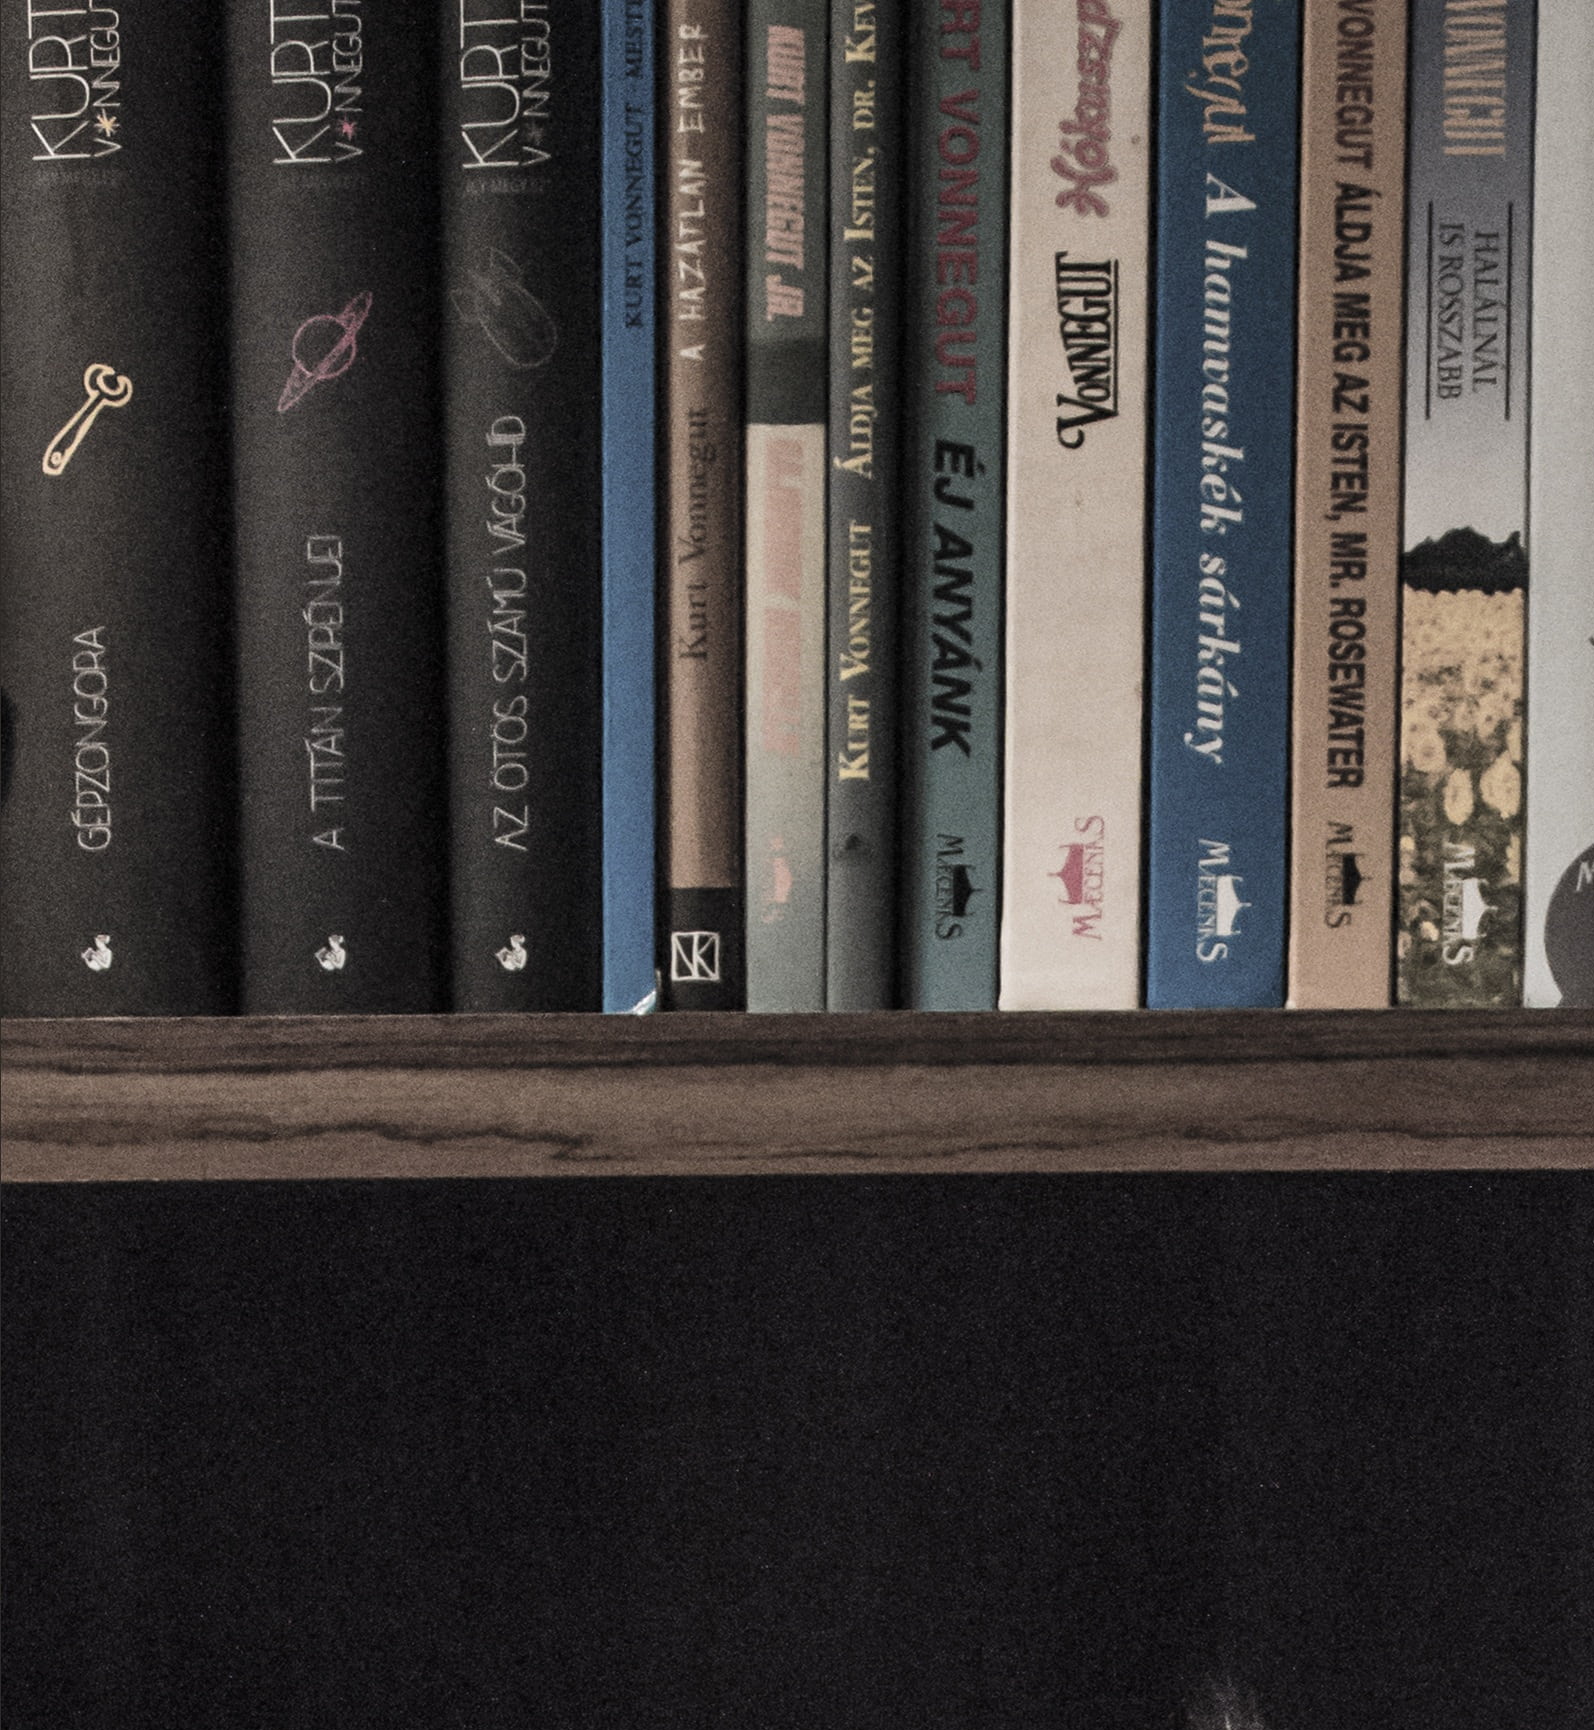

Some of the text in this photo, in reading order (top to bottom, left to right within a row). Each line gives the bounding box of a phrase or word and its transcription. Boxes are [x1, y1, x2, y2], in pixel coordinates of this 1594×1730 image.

[28, 0, 90, 161] KURT
[271, 0, 333, 163] KURT
[460, 0, 521, 168] KURT
[677, 23, 708, 362] A HAZÁTLAN EMBER
[625, 254, 644, 329] KURT
[851, 79, 877, 369] MEG AZ DR.
[933, 90, 982, 405] VONNEGUT
[1436, 256, 1465, 400] ROSSZABB
[1055, 250, 1119, 451] VONNEGUT
[1184, 172, 1257, 765] A hamvaskék sárkány
[1325, 181, 1383, 789] ÁLDJA MEG AZ MR. ROSEWATER
[486, 566, 529, 851] AZ ÖTÖS SZÁMÚ
[678, 582, 708, 661] Kurt
[839, 519, 873, 782] KURT VONNEGUT
[931, 438, 986, 759] ÉJ ANYÁNK
[73, 626, 111, 850] GÉPZONGORA
[304, 706, 346, 851] A TITÁN
